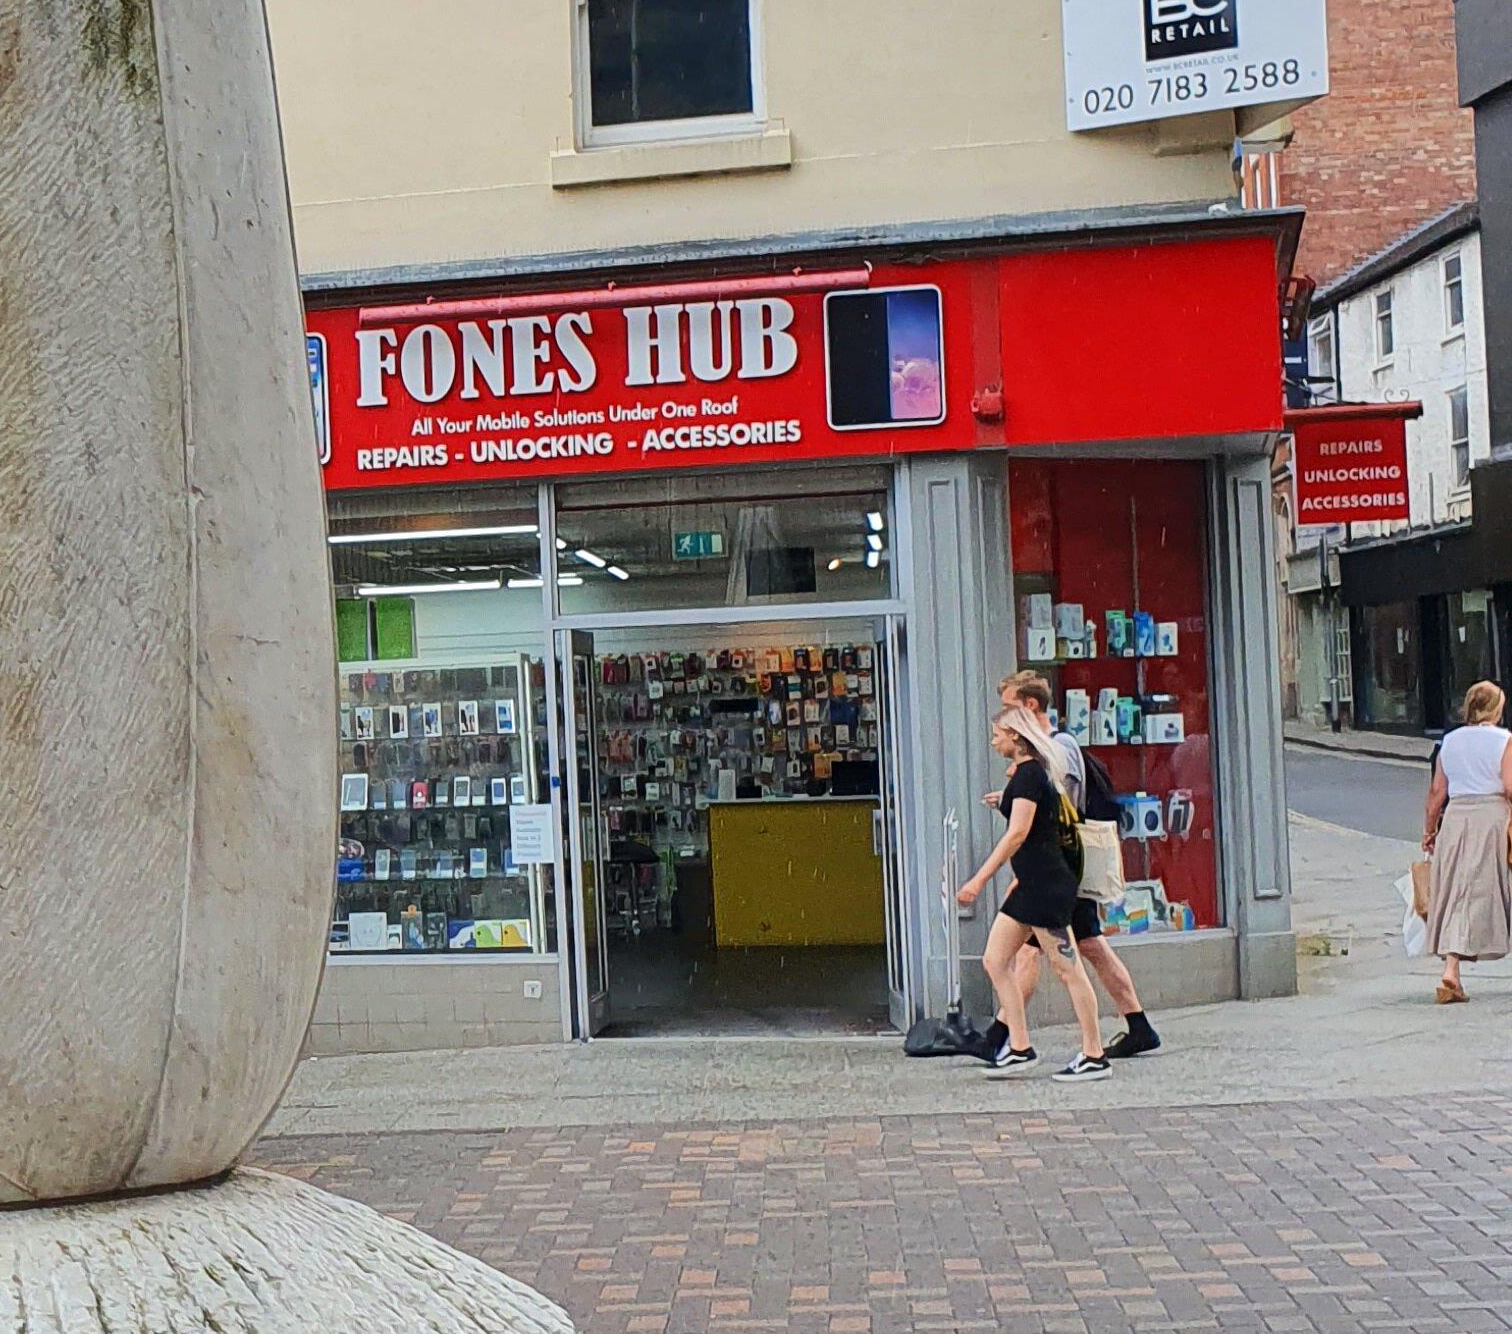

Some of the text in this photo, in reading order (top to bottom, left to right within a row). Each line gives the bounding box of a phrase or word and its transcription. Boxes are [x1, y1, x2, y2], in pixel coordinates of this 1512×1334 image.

[1151, 17, 1230, 43] RETAIL
[1084, 59, 1300, 114] 020 7183 2588
[355, 297, 798, 407] FONES HUB
[411, 396, 739, 436] All Your Mobile Solutions Under One Roof
[357, 444, 448, 470] REPAIRS
[470, 432, 614, 463] UNLOCKING
[641, 419, 802, 452] ACCESSORIES
[1320, 439, 1383, 456] REPAIRS
[1304, 465, 1401, 483] UNLOCKING
[1302, 492, 1406, 510] ACCESSORIES
